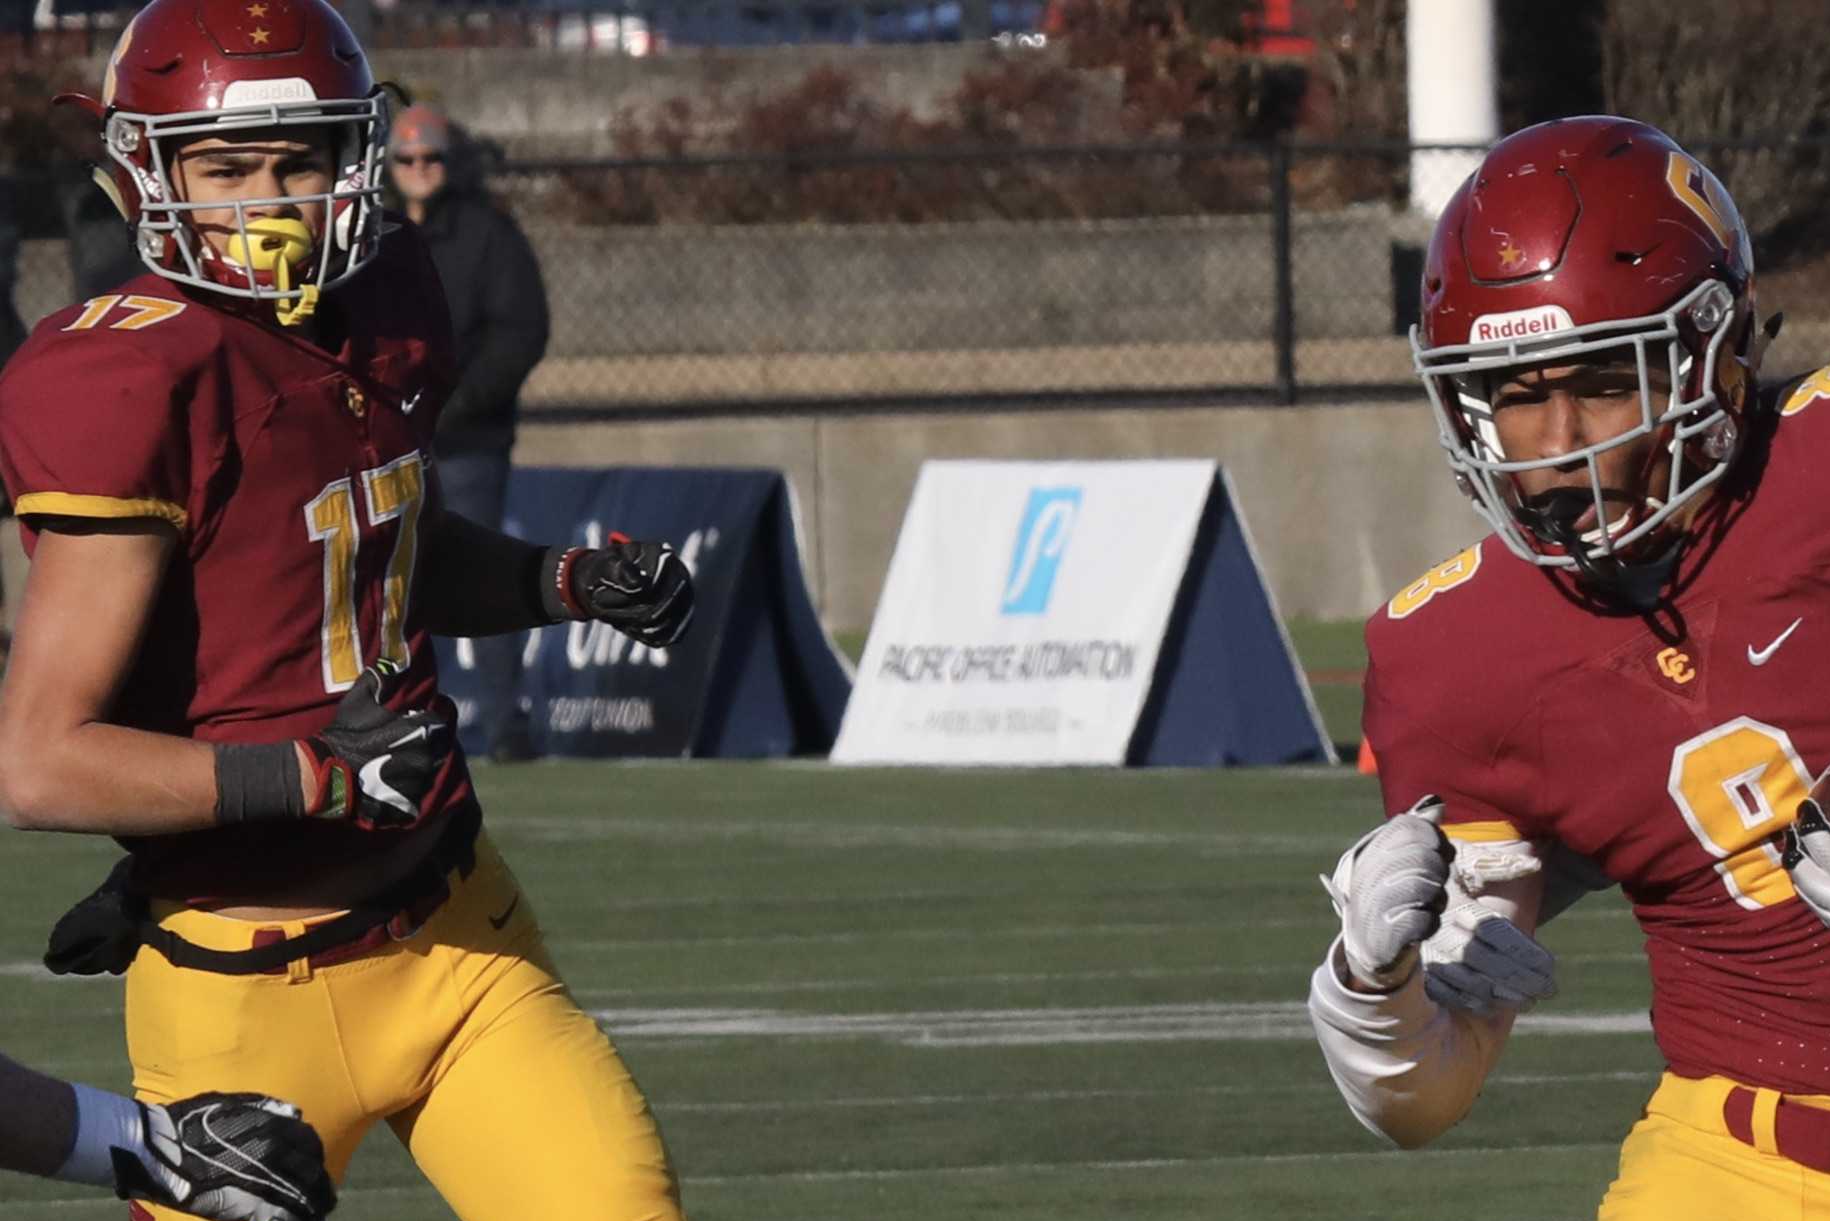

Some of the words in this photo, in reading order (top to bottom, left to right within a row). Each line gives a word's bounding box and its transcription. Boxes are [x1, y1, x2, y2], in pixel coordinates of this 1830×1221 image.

[61, 294, 187, 332] 17
[1478, 312, 1557, 340] Riddell
[303, 449, 424, 694] 17
[1388, 542, 1483, 619] 8
[1667, 714, 1816, 911] 8
